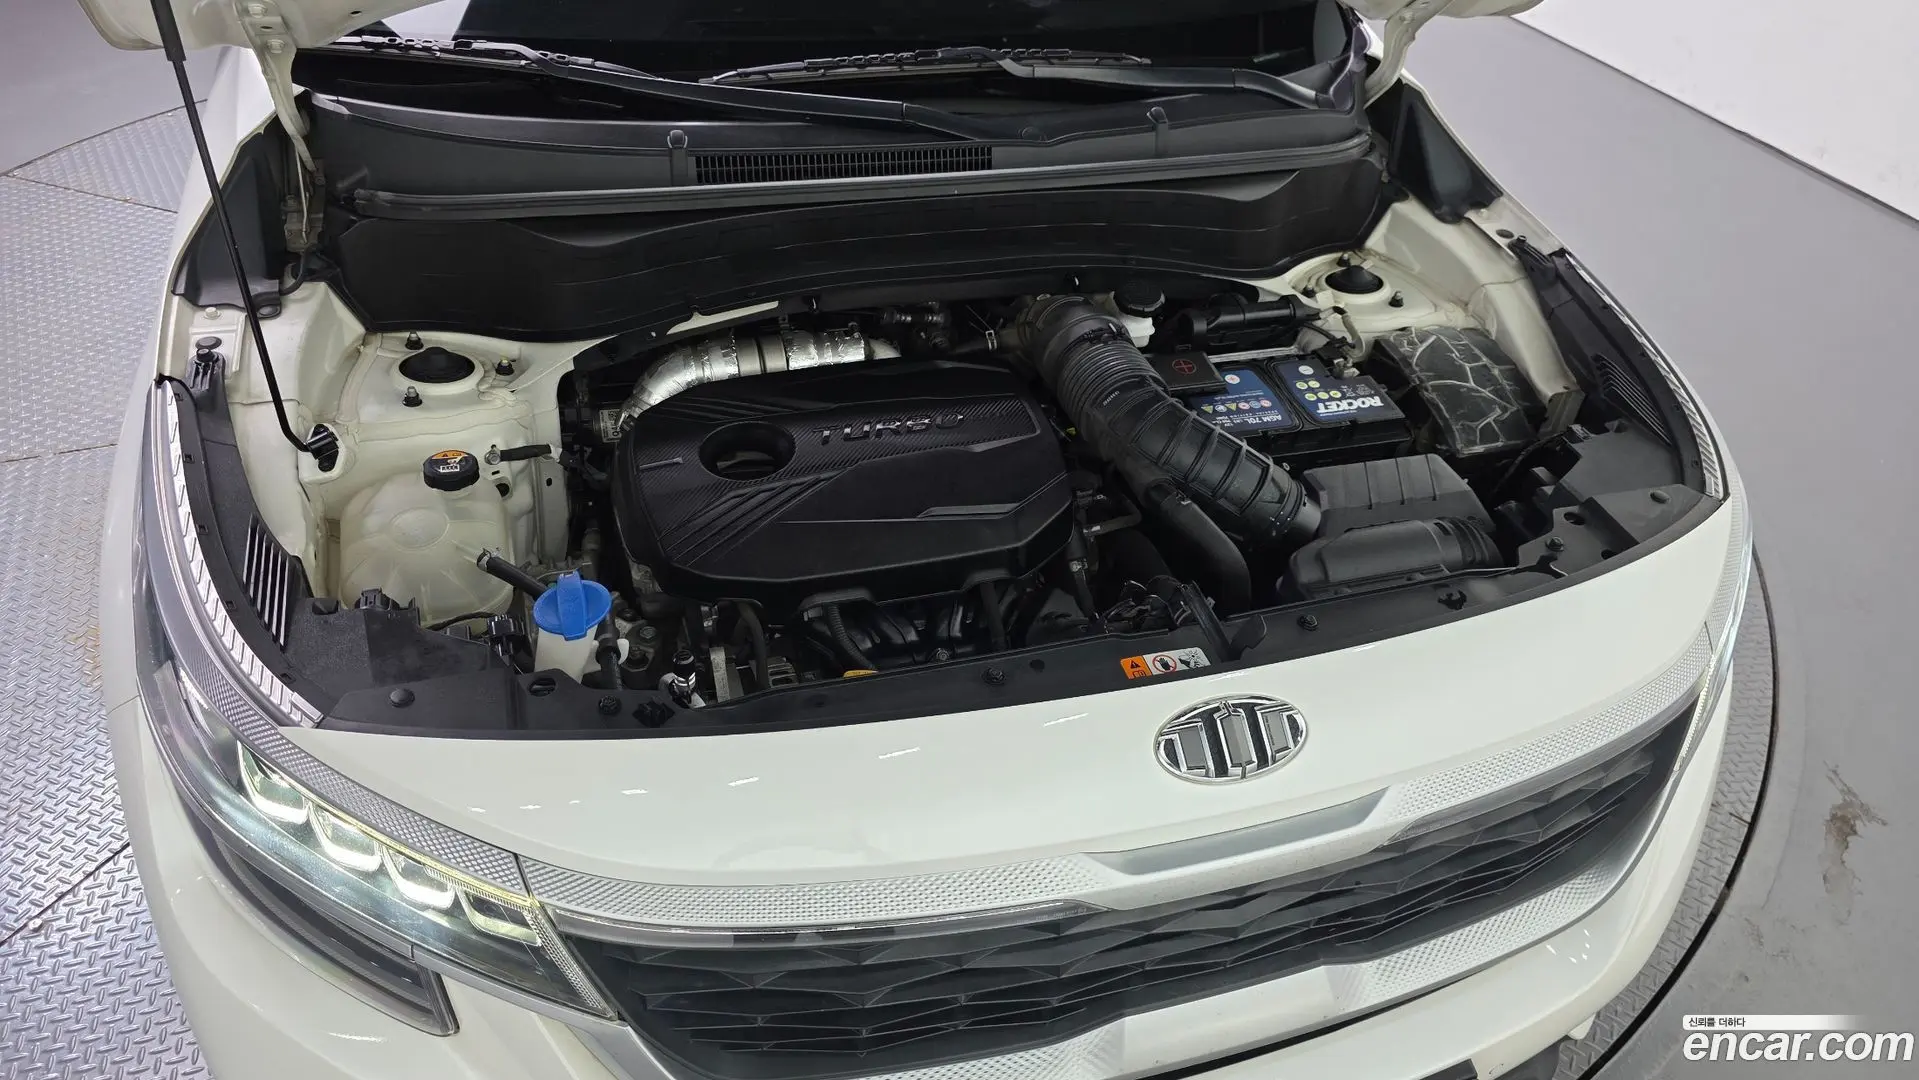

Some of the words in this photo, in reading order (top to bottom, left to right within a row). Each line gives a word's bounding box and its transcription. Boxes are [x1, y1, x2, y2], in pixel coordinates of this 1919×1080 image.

[1317, 395, 1384, 413] ROCKET
[1262, 414, 1282, 422] AGM
[812, 413, 964, 446] TURBO
